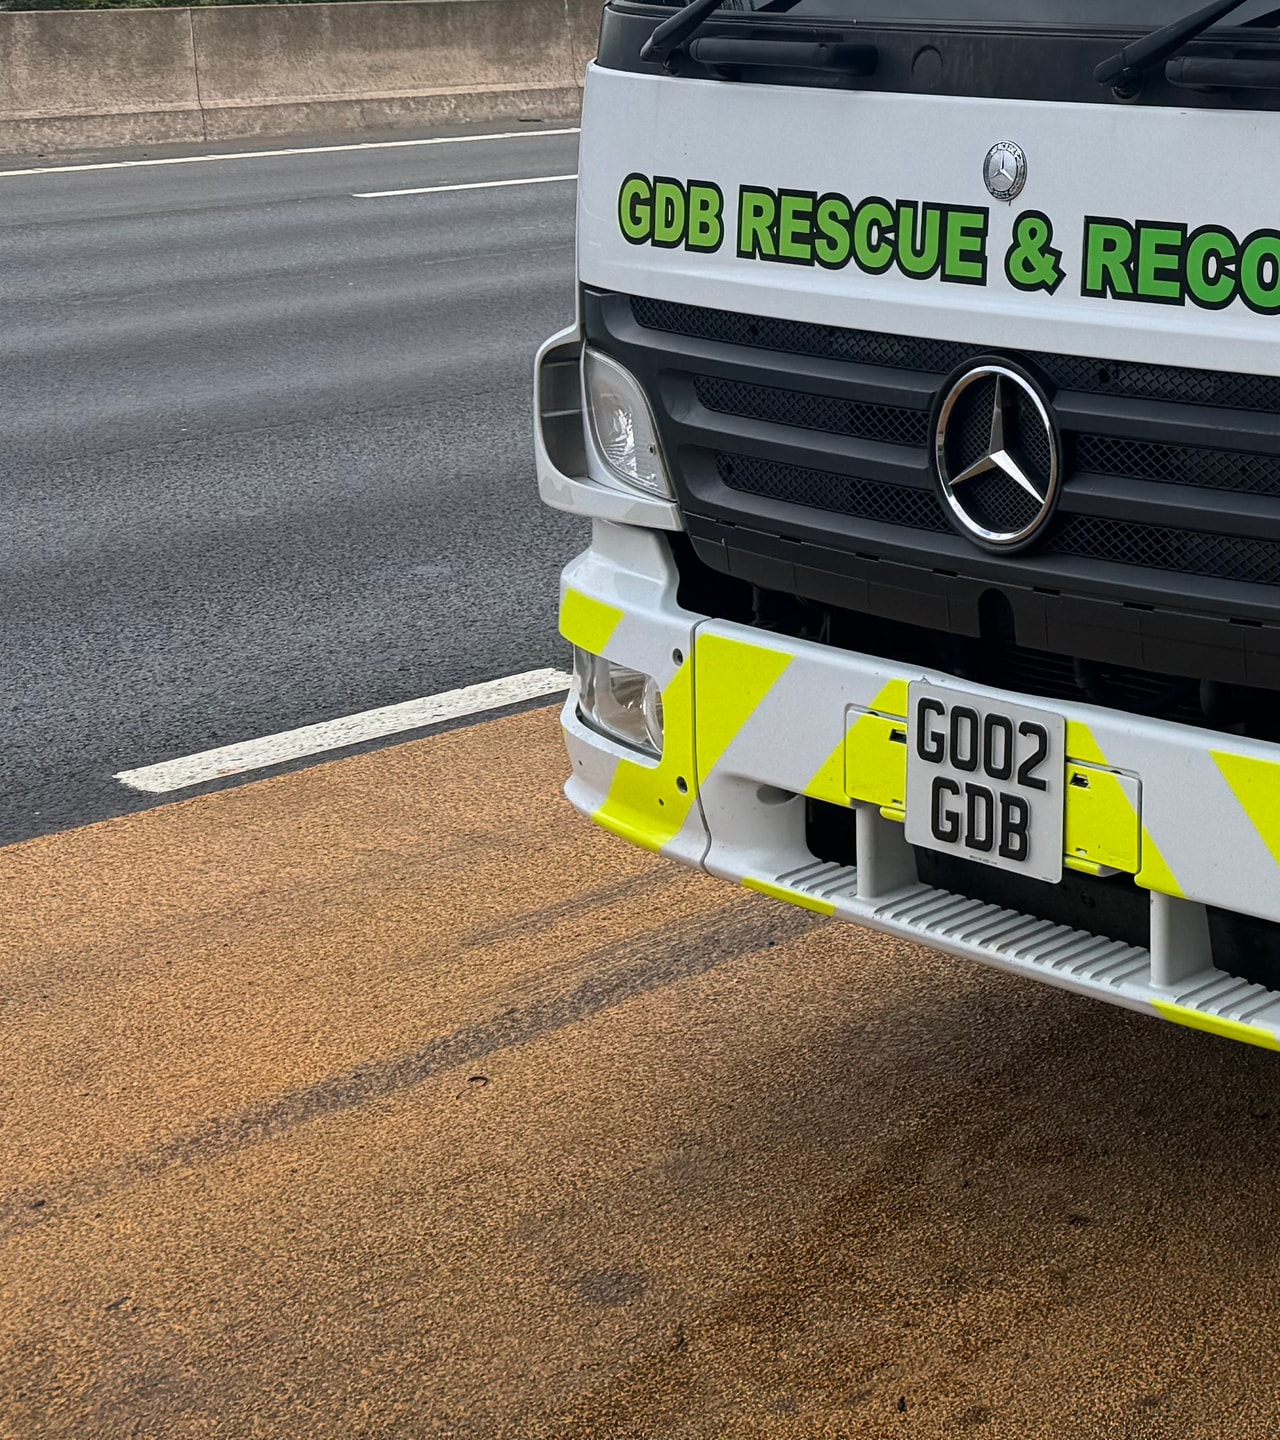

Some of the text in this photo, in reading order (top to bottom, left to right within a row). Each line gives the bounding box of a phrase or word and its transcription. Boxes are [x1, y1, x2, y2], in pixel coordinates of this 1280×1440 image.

[616, 172, 724, 253] GDB
[736, 185, 988, 284] RESCUE
[1003, 209, 1066, 296] &
[931, 775, 1030, 862] GDB
